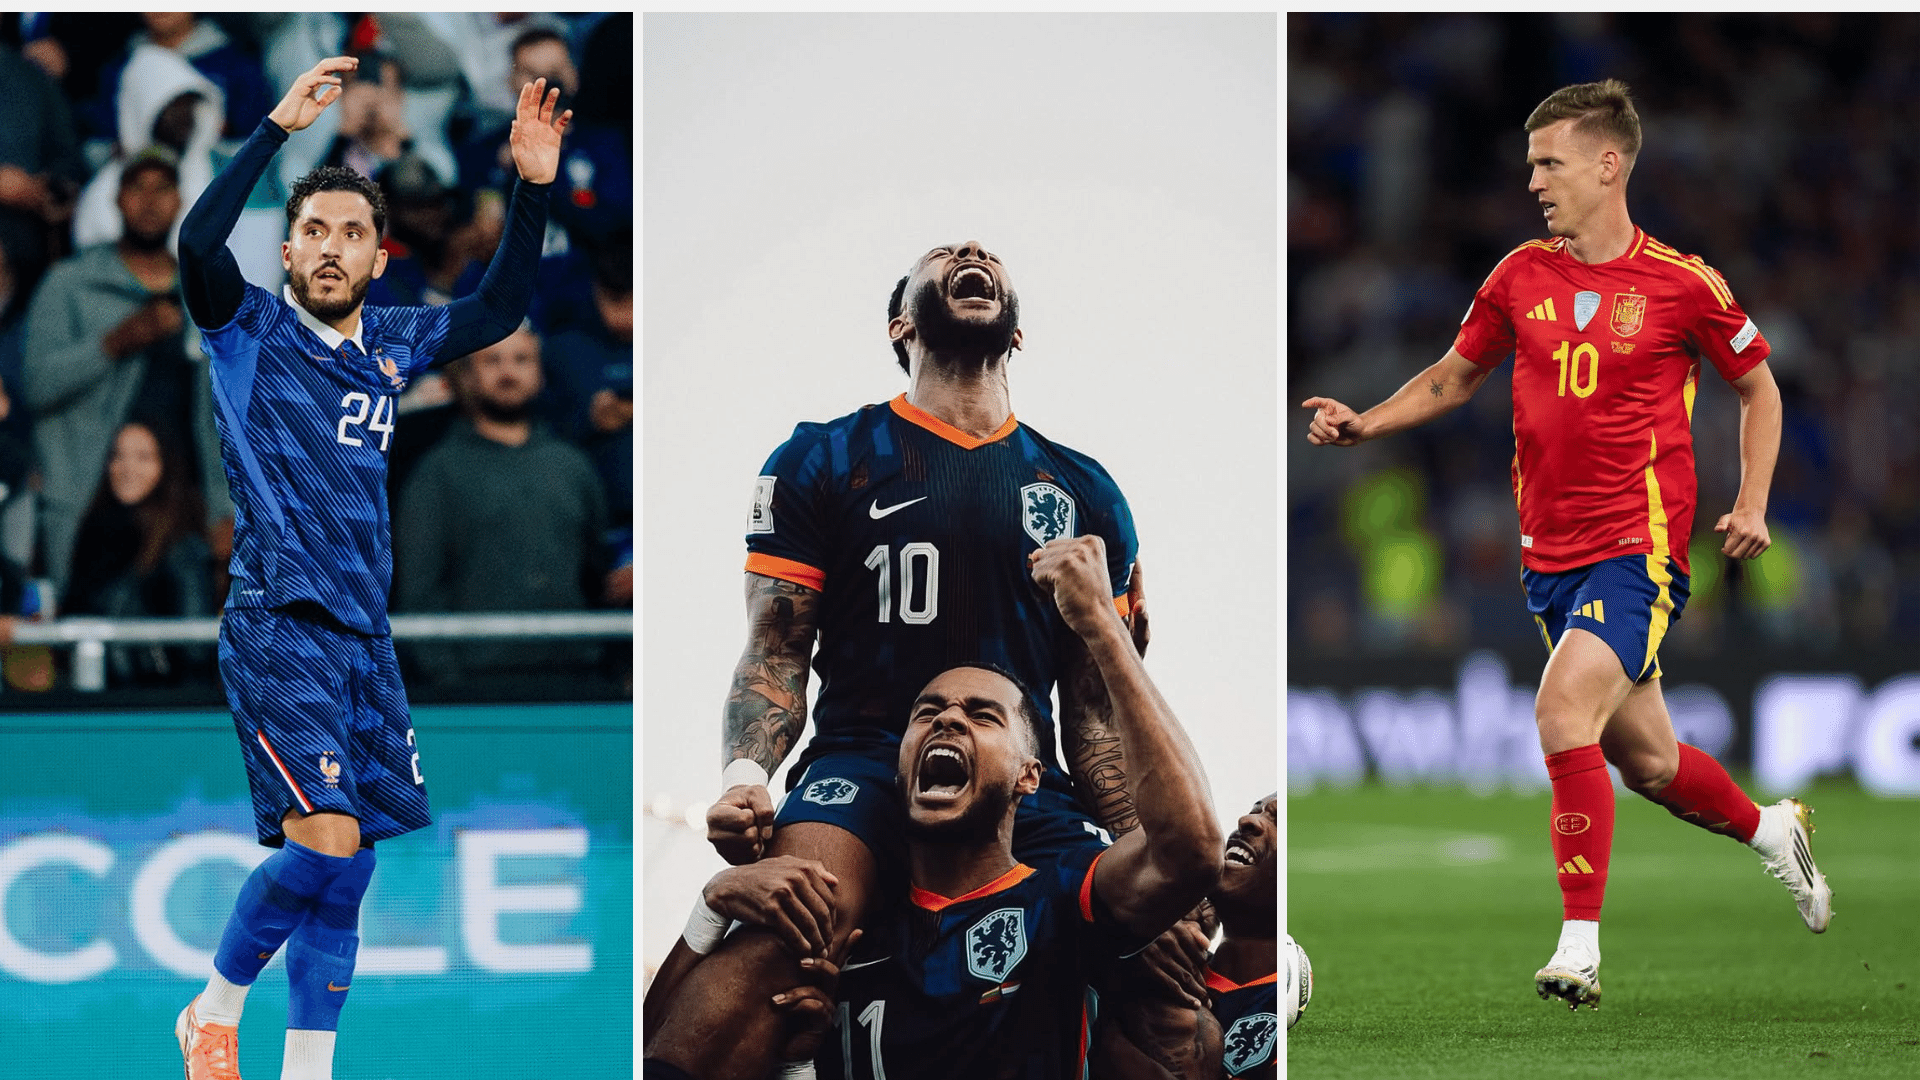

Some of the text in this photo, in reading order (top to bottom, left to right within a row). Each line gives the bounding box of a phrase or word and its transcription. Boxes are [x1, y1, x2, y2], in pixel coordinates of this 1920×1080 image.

[1552, 341, 1599, 399] 10
[337, 391, 394, 451] 24
[864, 542, 939, 625] 10
[833, 1000, 887, 1080] 11
